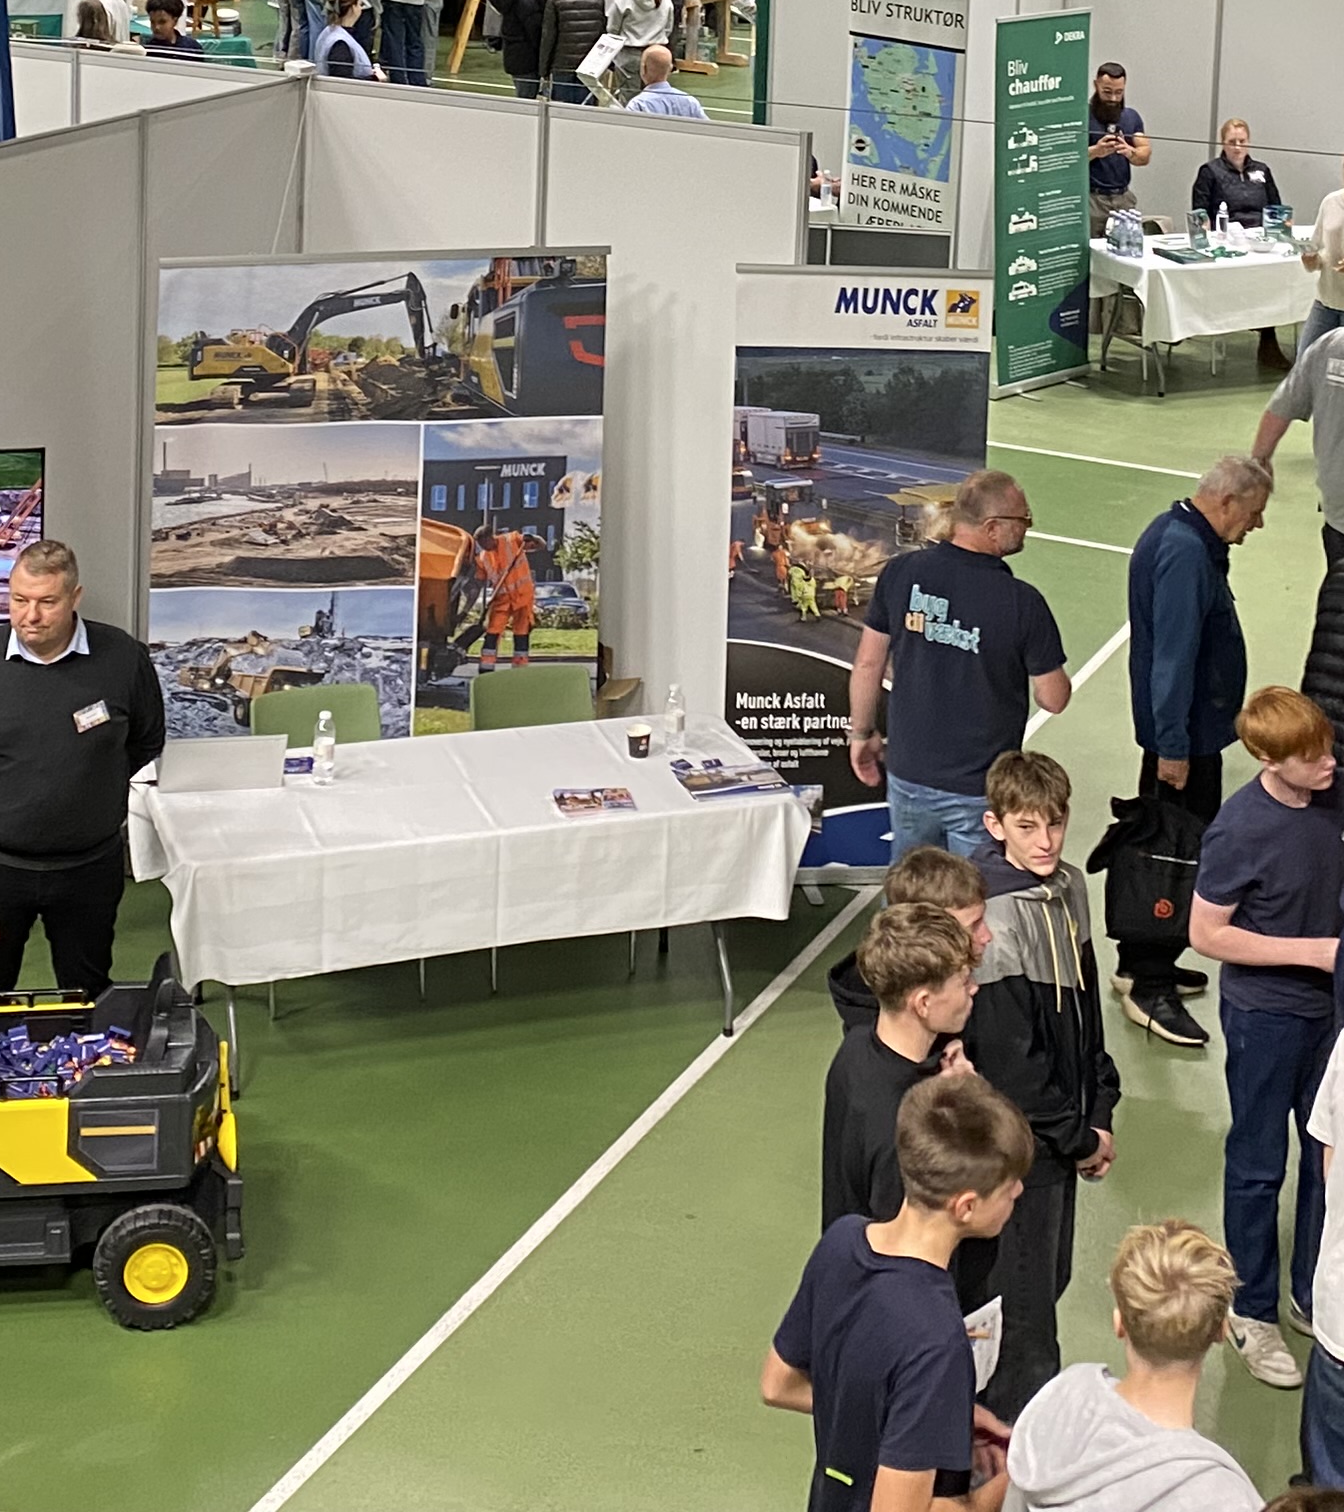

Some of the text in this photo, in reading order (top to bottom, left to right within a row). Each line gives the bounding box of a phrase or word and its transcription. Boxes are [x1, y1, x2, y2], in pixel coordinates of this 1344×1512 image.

[886, 2, 965, 30] STRUKTØR
[1064, 31, 1085, 42] DEKRA
[1008, 60, 1028, 76] Bliv
[1008, 74, 1062, 96] chauffør
[851, 172, 941, 204] HER ER MÅSKE
[848, 192, 943, 224] DIN KOMMENDE
[834, 287, 939, 316] MUNCK
[906, 318, 938, 328] ASFALT
[500, 462, 546, 478] MUNCK
[909, 584, 950, 622] byg
[736, 692, 826, 709] Munck Asfalt
[735, 716, 758, 730] -en
[760, 714, 800, 730] stærk
